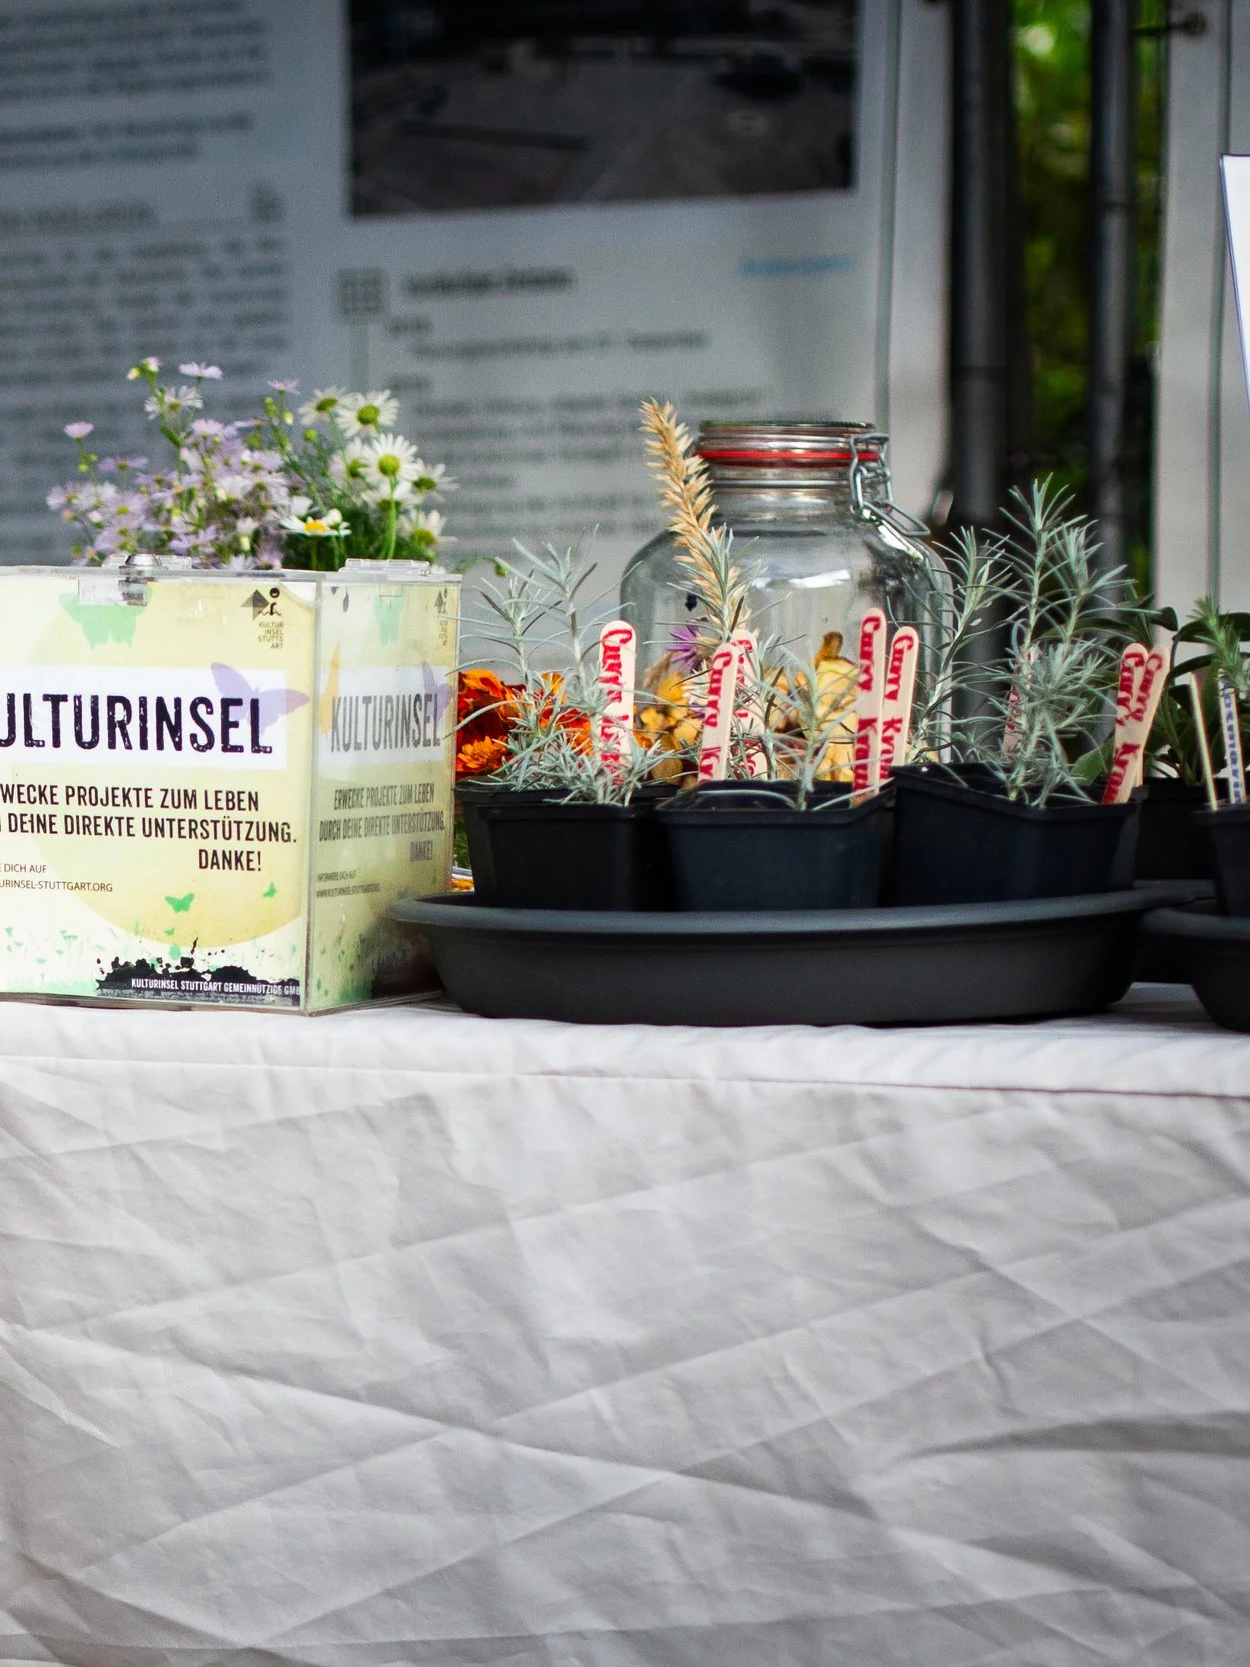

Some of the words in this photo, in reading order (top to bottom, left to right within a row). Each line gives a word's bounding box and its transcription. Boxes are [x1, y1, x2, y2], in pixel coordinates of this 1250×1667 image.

[857, 616, 881, 691] Curry
[884, 634, 914, 701] Curry
[705, 651, 733, 727] Curry
[331, 693, 441, 752] KULTURINSEL
[65, 785, 154, 808] PROJEKTE
[159, 788, 197, 810] ZUM
[204, 790, 259, 811] LEBEN
[334, 787, 364, 810] ERWECKE
[366, 785, 398, 808] PROJEKTE
[399, 784, 413, 805] ZUM
[414, 783, 435, 804] LEBEN
[8, 812, 58, 834] DEINE
[64, 814, 136, 837] DIREKTE
[142, 816, 297, 843] UNTERSTÜTZUNG.
[319, 820, 341, 841] DURCH
[343, 818, 362, 839] DEINE
[364, 815, 390, 837] DIREKTE
[4, 863, 27, 873] DICH
[29, 864, 48, 873] AUF
[198, 849, 262, 871] DANKE!
[131, 978, 179, 990] KULTURINSEL
[180, 981, 222, 992] STUTTGART
